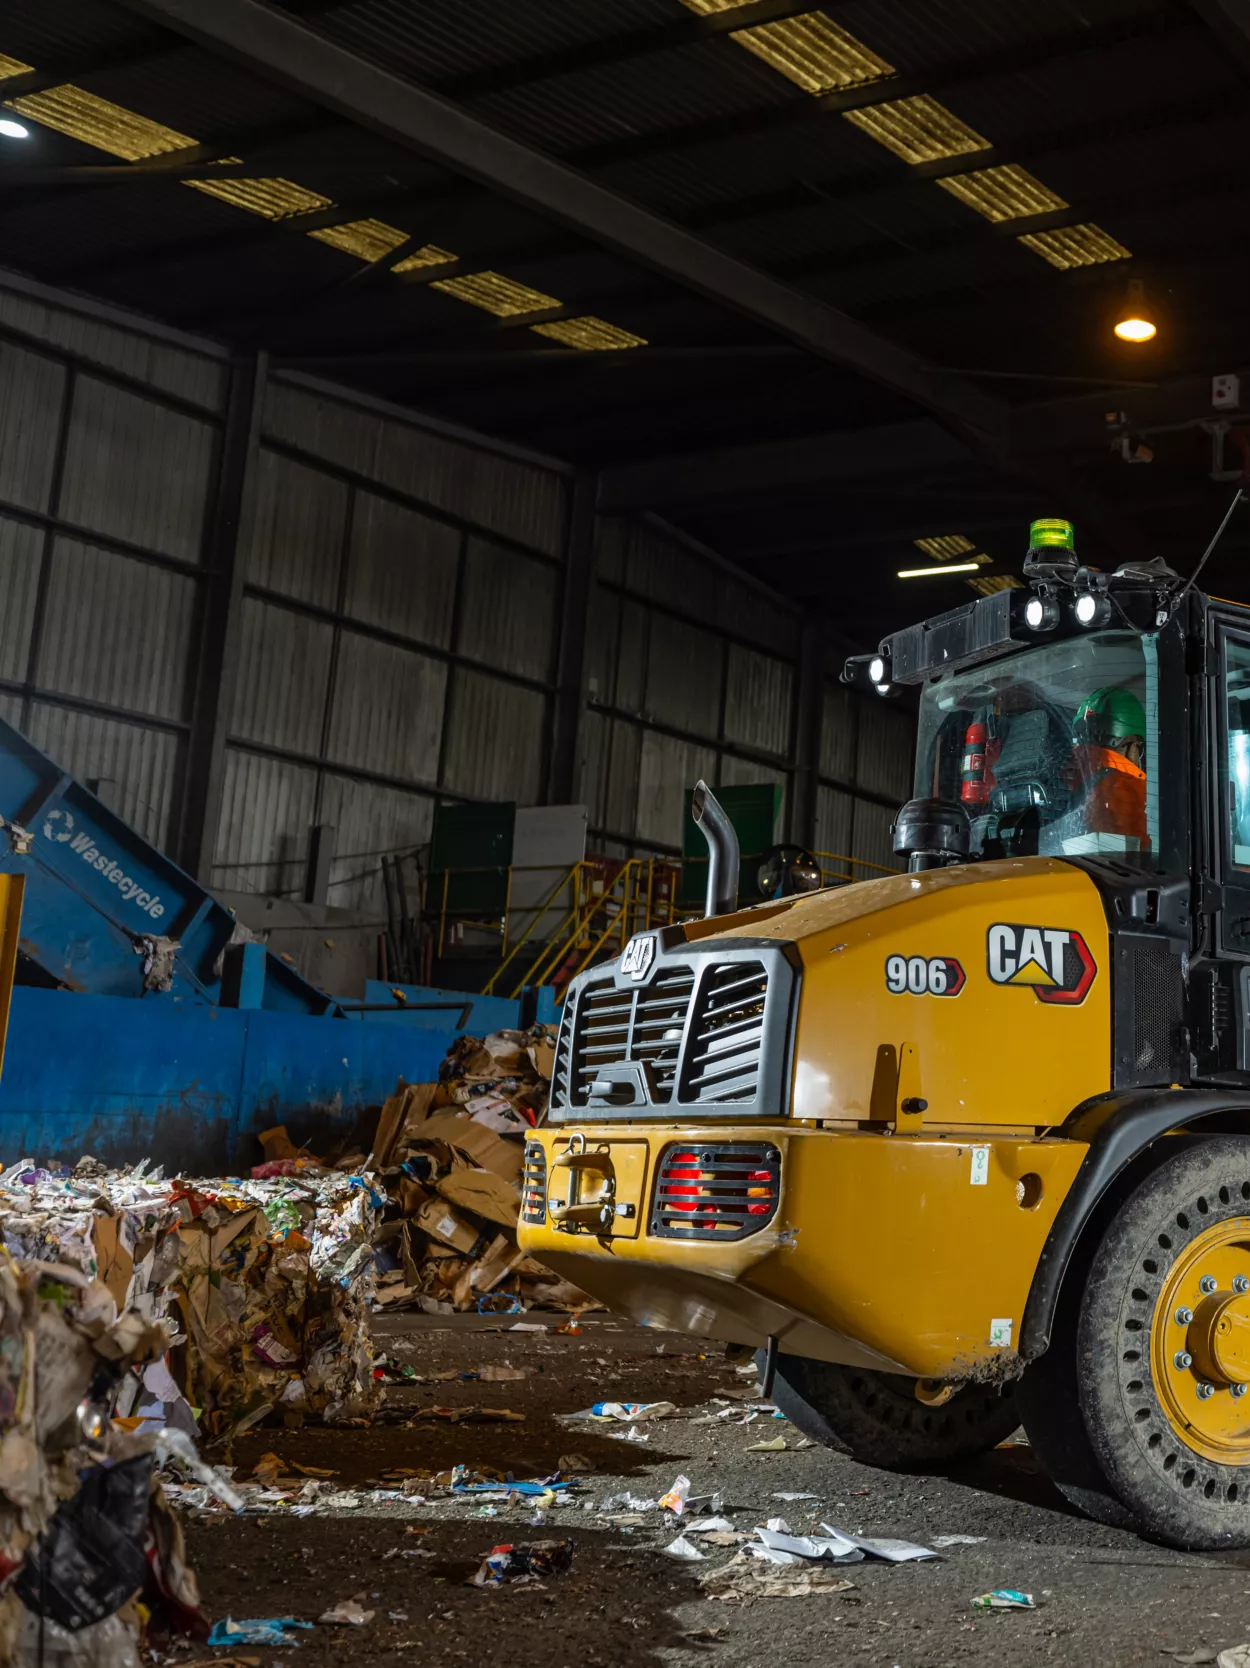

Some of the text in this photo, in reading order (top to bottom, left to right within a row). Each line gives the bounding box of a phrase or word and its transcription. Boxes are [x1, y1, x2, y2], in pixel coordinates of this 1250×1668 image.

[70, 831, 164, 919] Wastecycle
[621, 937, 650, 973] CAT
[887, 955, 947, 994] 906
[988, 924, 1069, 986] CAT
